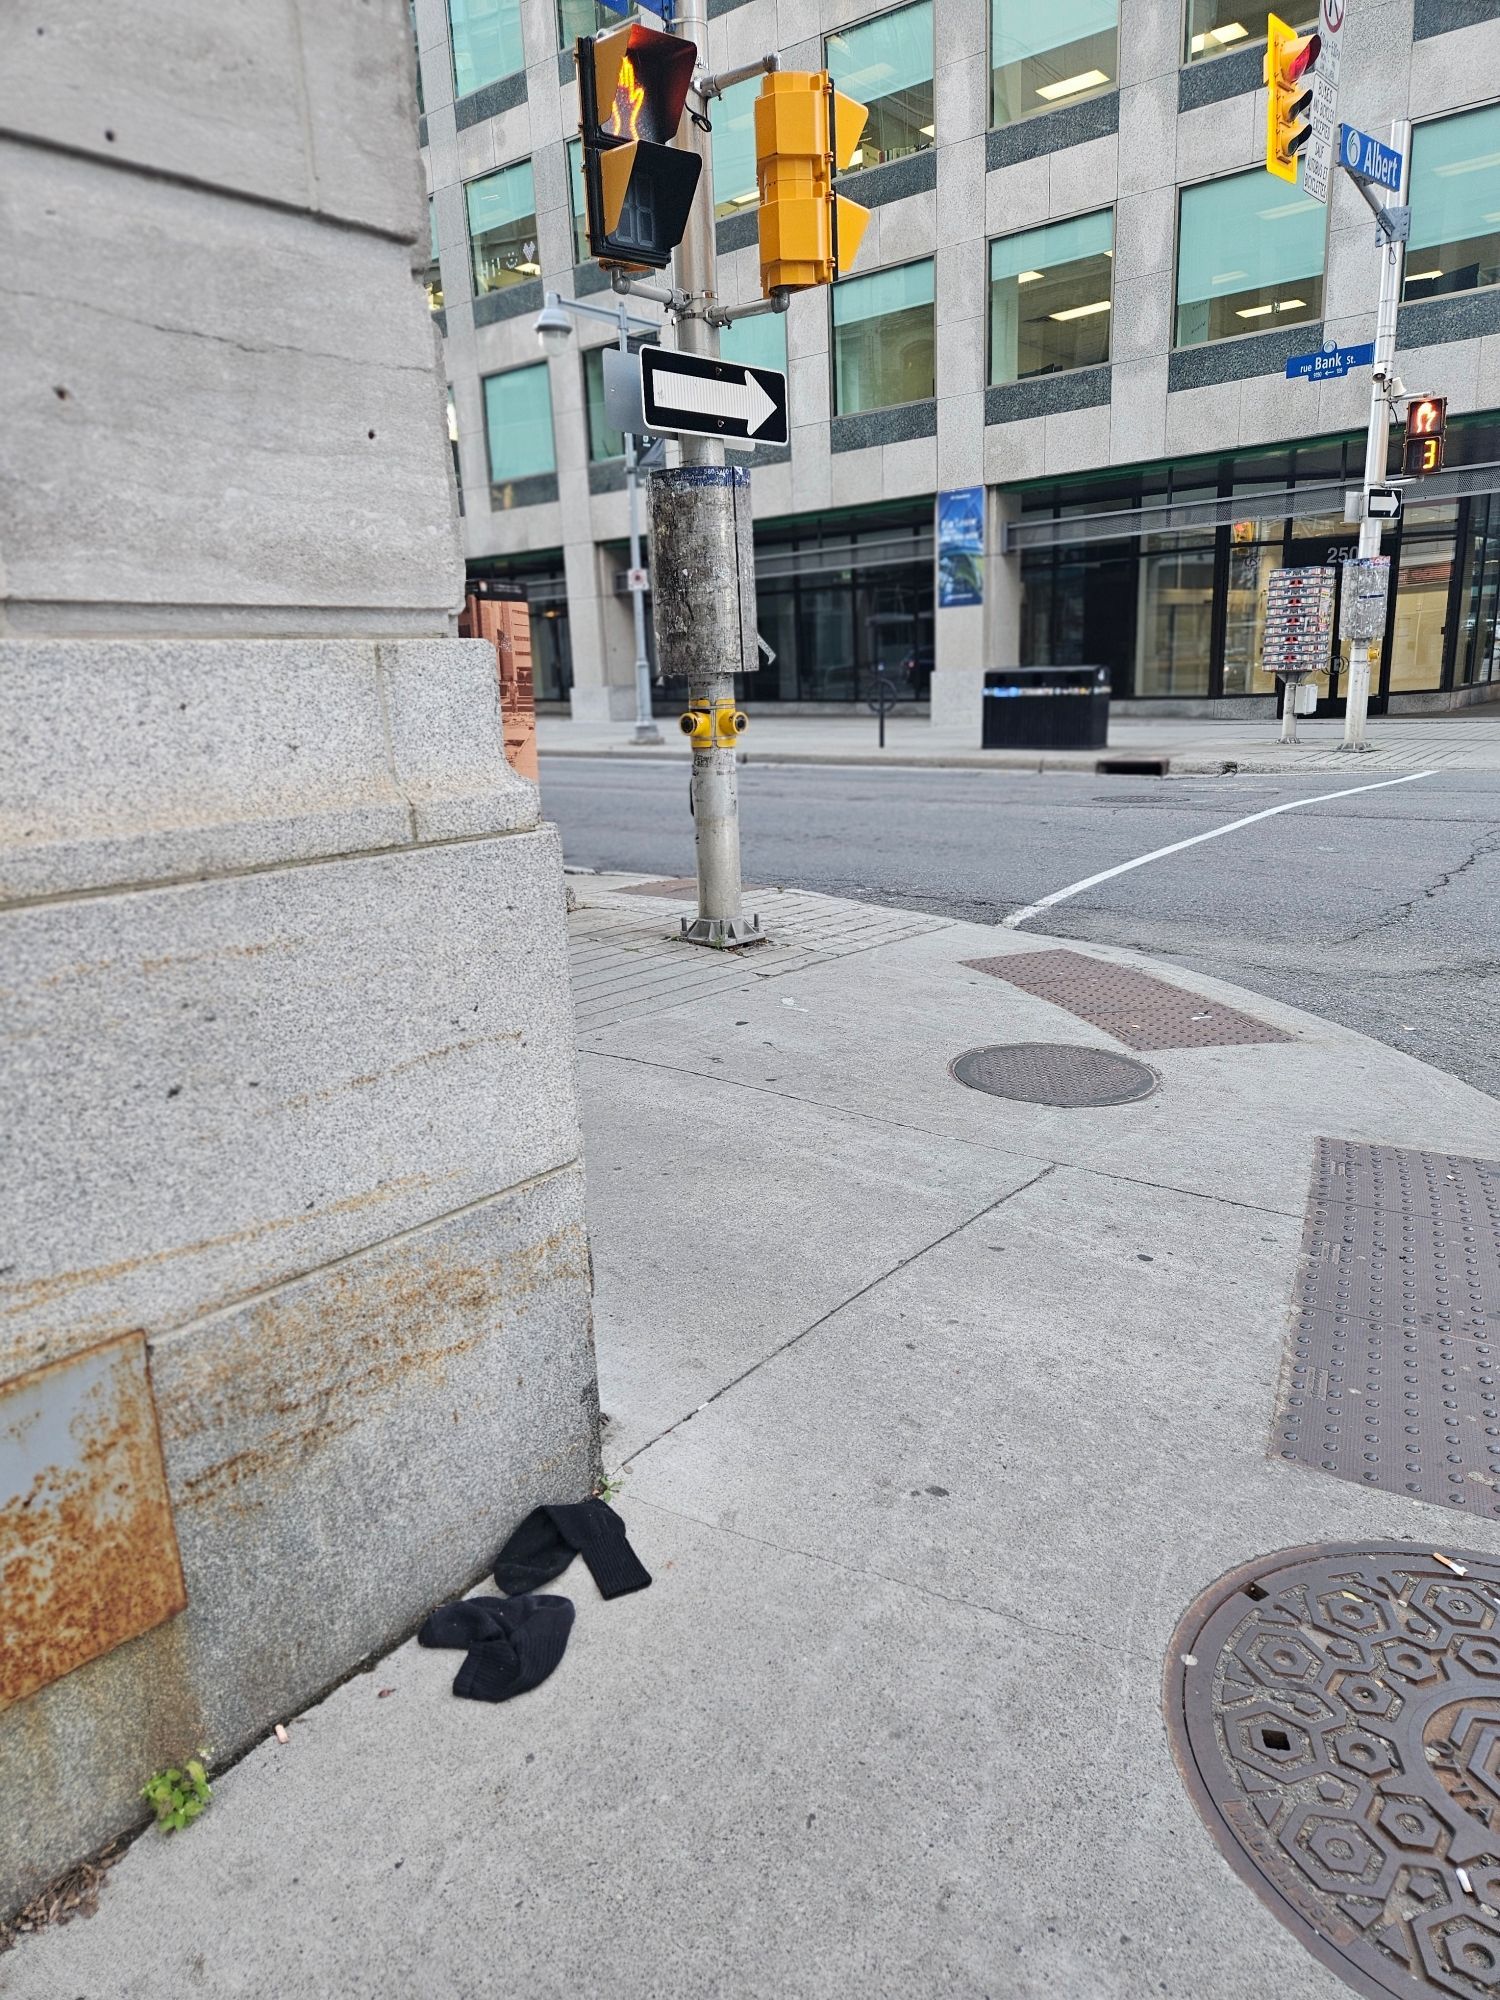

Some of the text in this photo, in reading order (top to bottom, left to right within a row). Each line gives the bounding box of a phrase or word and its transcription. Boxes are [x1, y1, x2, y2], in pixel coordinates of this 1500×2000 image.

[1363, 141, 1398, 188] Albert
[1300, 352, 1356, 373] rue Bank St.
[1422, 439, 1437, 470] 3
[1326, 545, 1359, 564] 250
